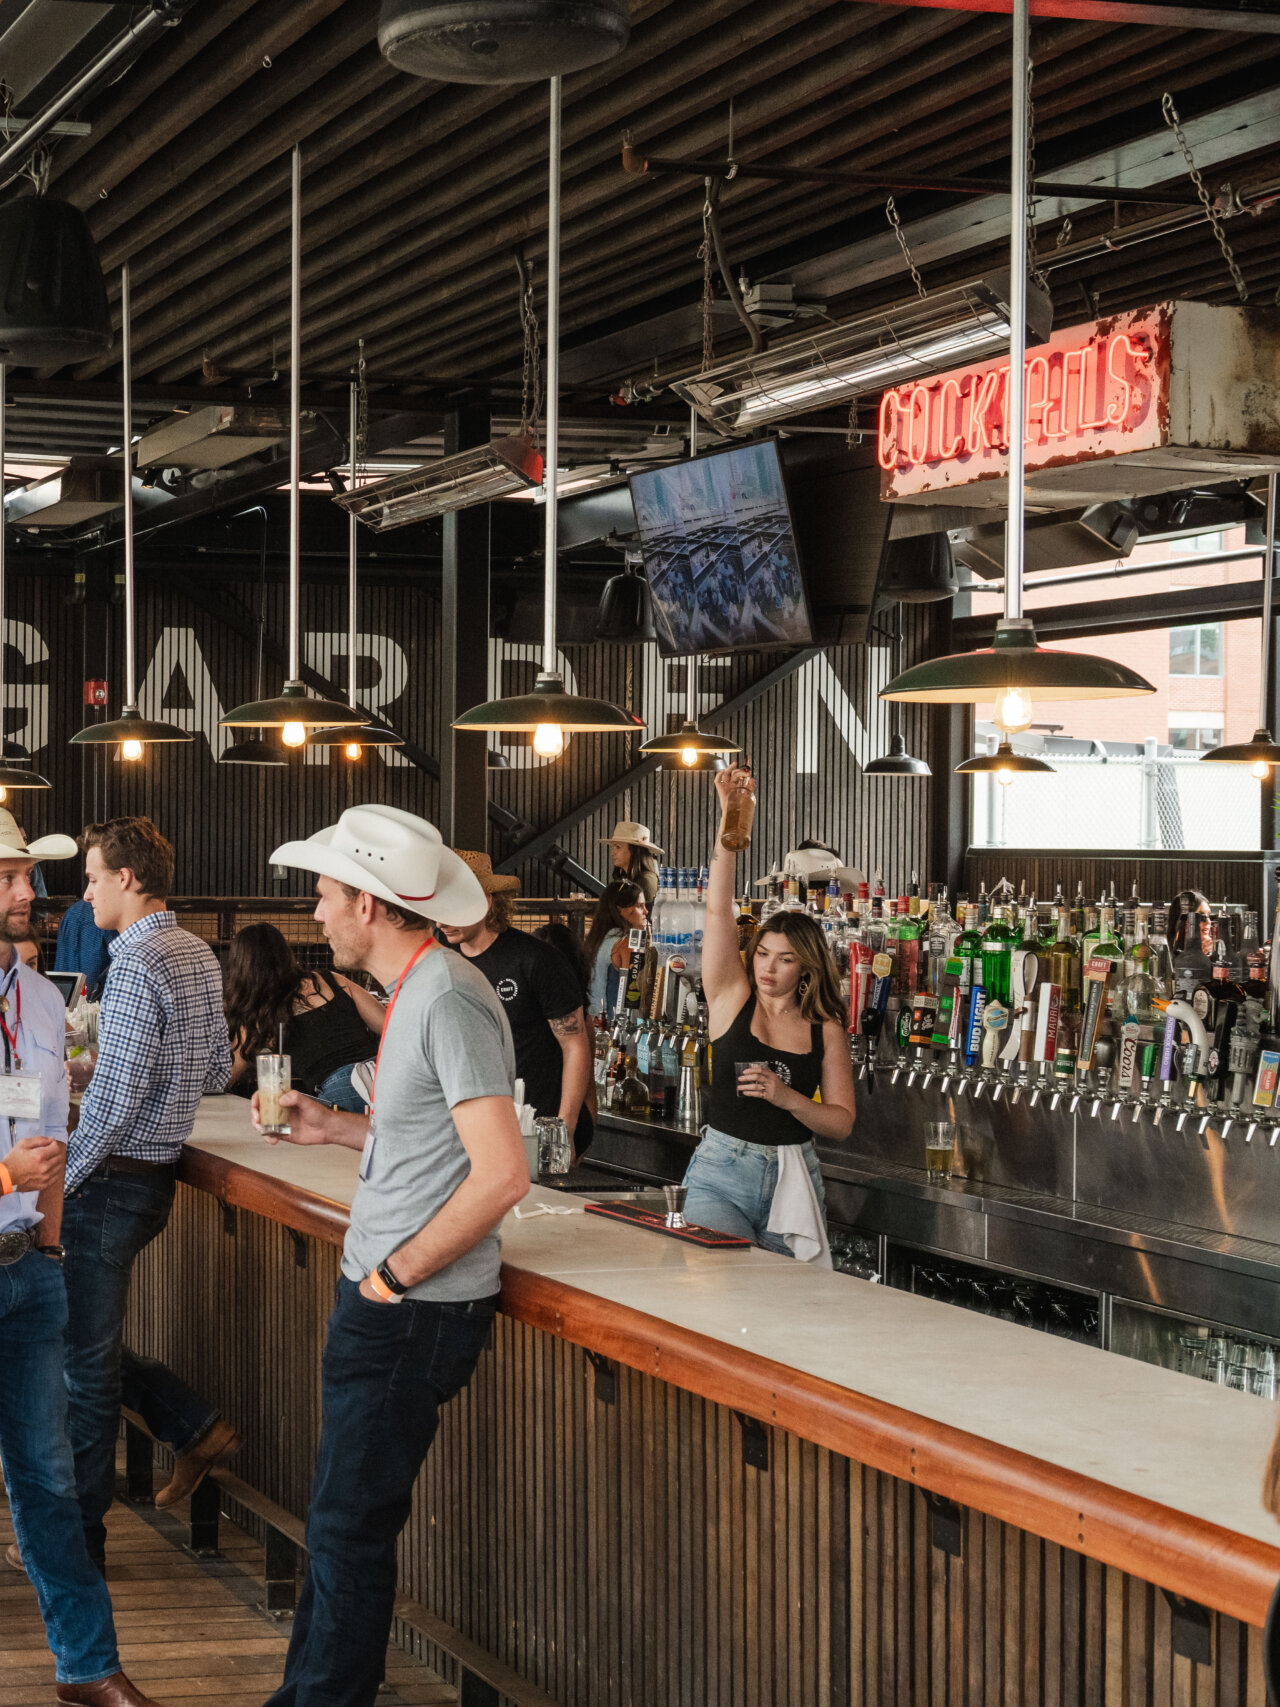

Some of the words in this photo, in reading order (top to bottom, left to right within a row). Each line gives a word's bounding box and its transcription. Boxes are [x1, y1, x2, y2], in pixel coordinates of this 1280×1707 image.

[631, 953, 641, 980] GUAVA
[1091, 960, 1107, 969] CRAFT
[974, 991, 987, 1027] LIGHT
[969, 1027, 982, 1052] BUD
[1121, 1037, 1138, 1079] Coors
